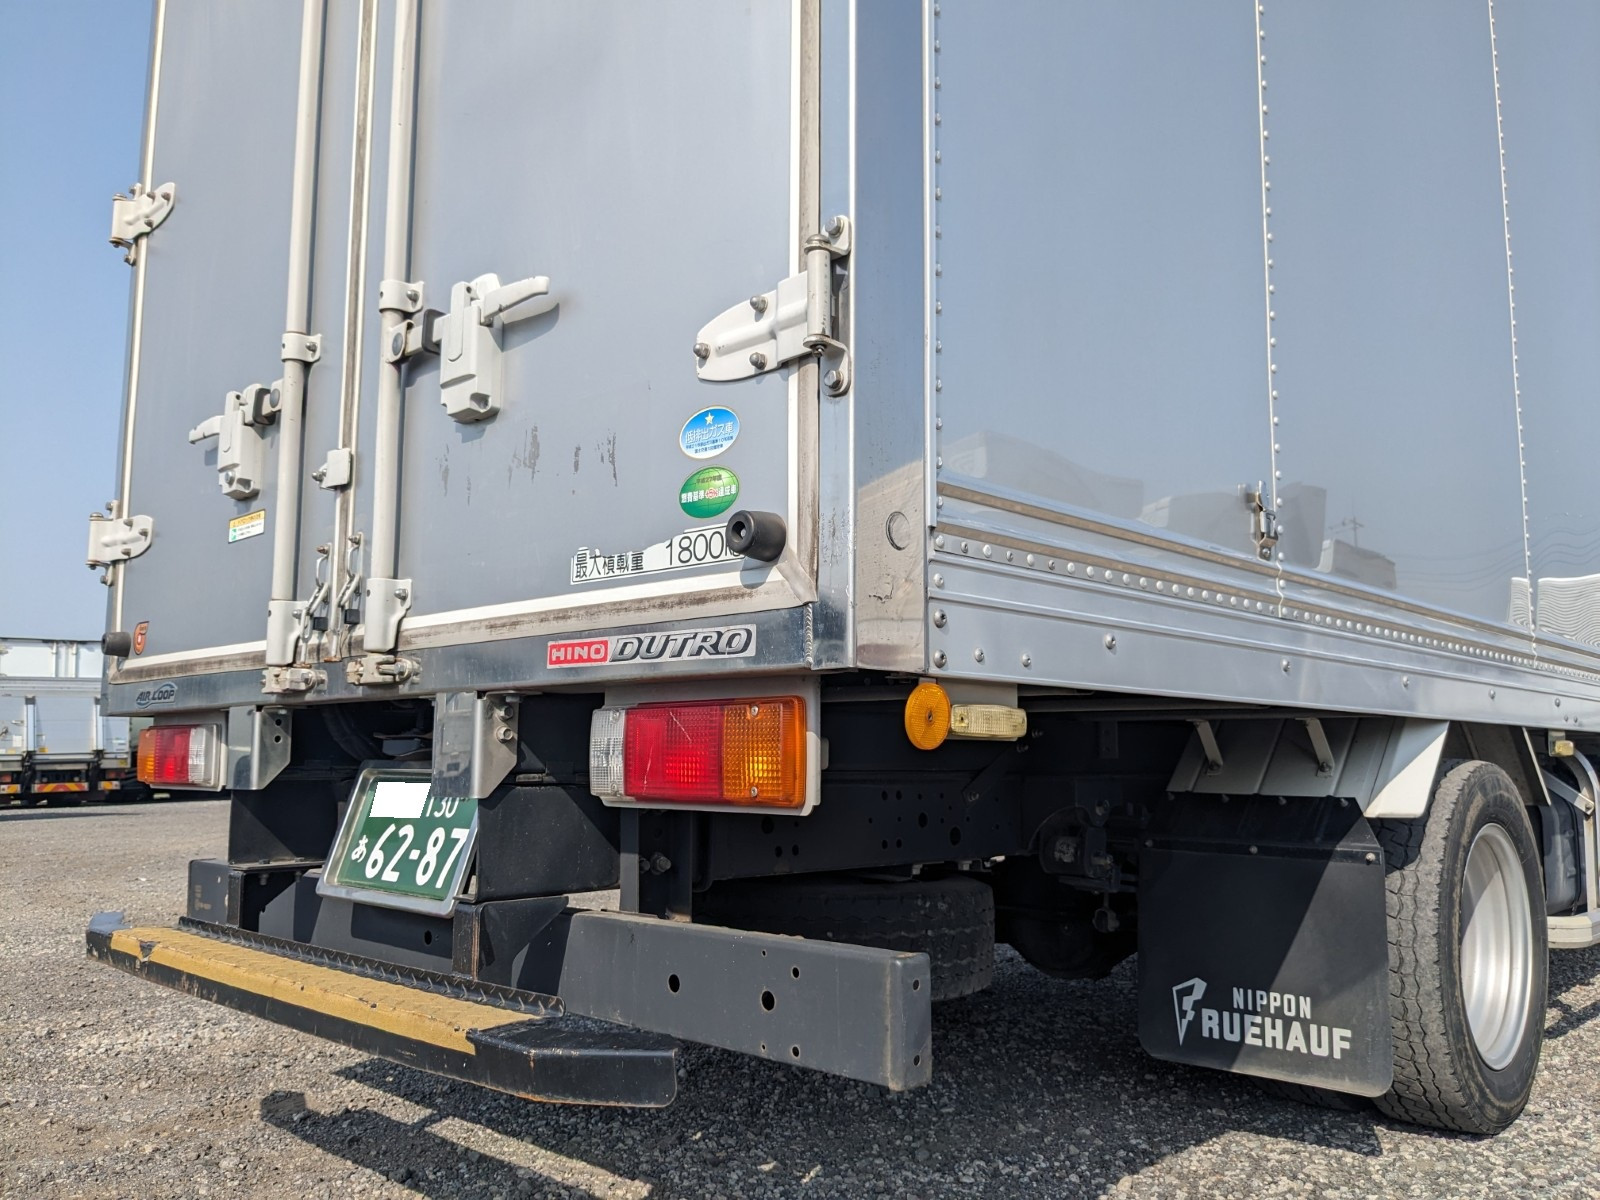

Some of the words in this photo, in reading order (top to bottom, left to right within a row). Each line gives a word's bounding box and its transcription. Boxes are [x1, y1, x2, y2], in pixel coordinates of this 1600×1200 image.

[685, 422, 734, 445] 低排出ガス車
[551, 641, 606, 661] HINO
[609, 628, 753, 662] DUTRO
[136, 691, 151, 702] AIR
[152, 689, 175, 701] LOOP
[351, 834, 369, 863] あ
[1232, 987, 1312, 1020] NIPPON
